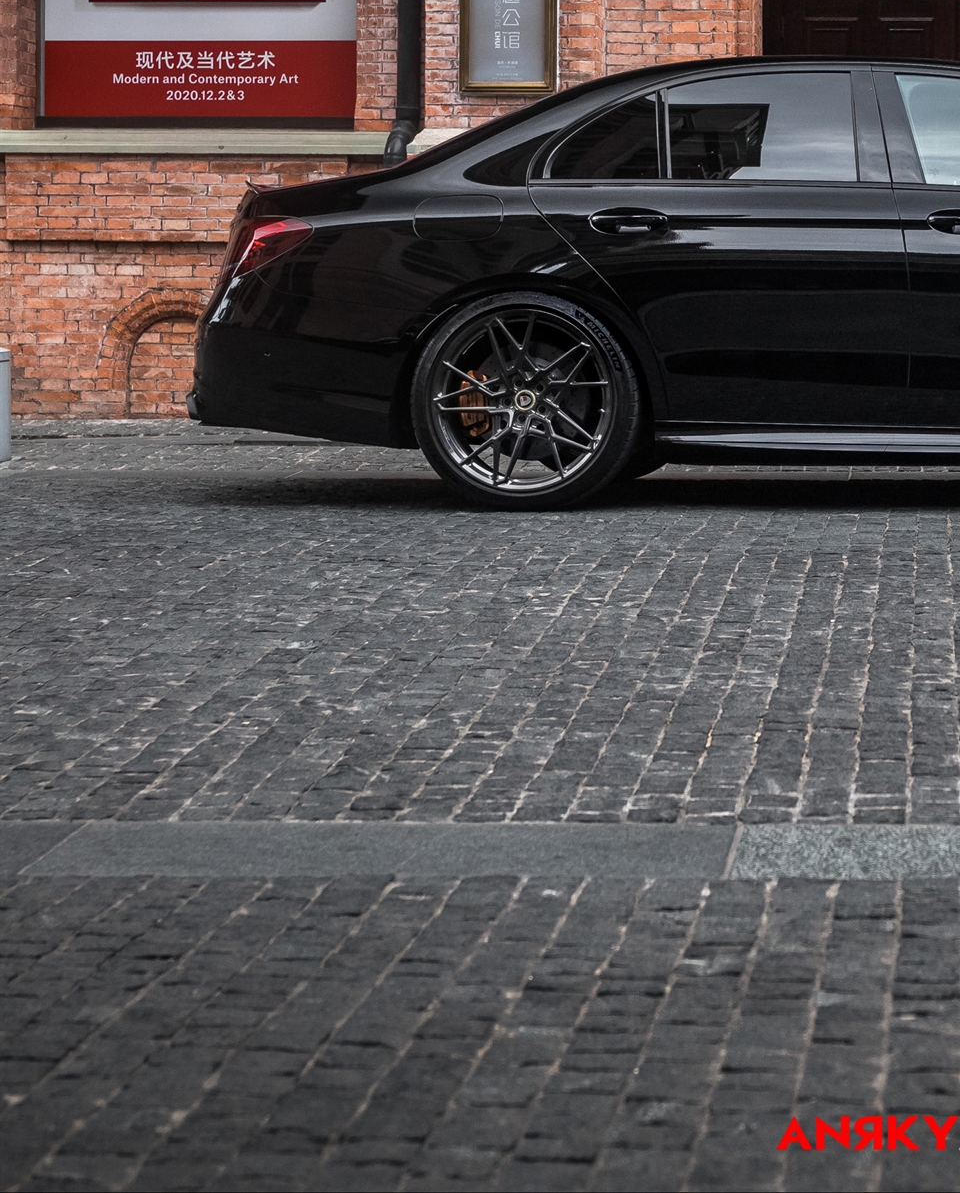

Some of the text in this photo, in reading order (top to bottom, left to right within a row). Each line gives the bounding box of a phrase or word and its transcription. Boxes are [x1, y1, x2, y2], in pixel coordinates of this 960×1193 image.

[135, 51, 276, 70] 现代及当代艺术
[112, 73, 299, 86] Modern and Contemporary Art
[586, 321, 621, 369] MICHELIN
